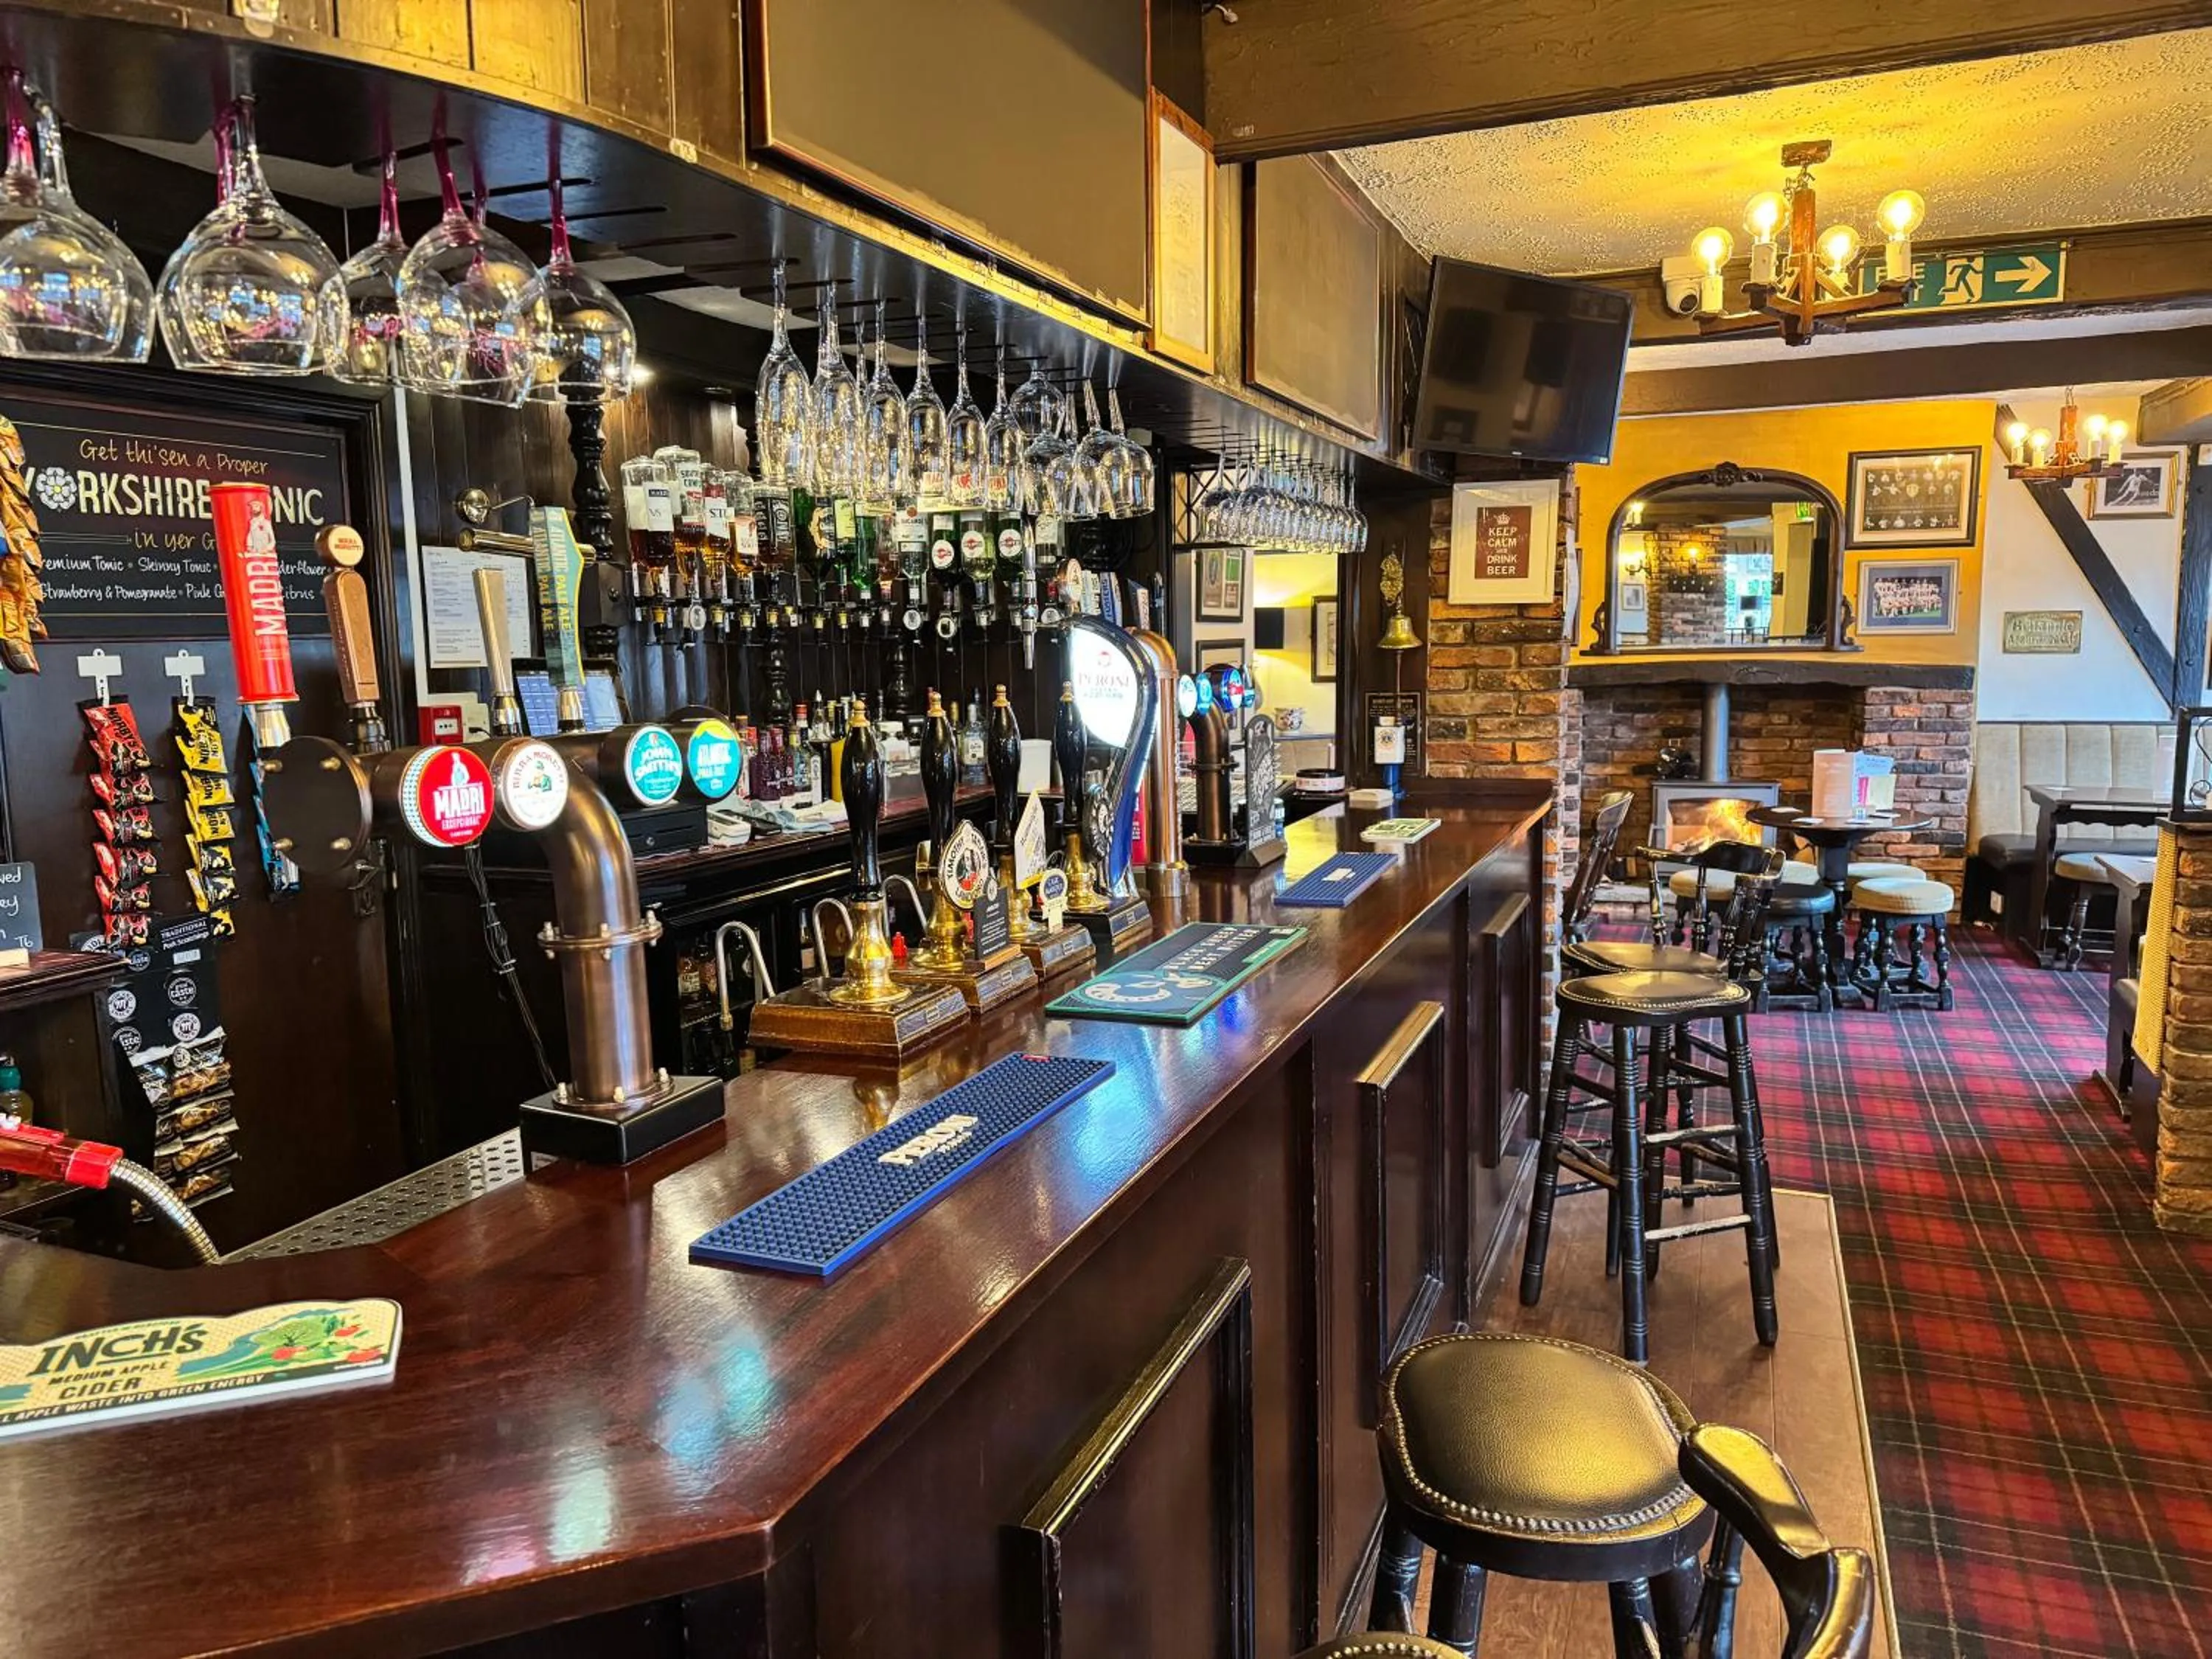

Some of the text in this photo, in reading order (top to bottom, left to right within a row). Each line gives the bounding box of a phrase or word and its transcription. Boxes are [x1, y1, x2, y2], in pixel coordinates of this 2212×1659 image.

[1876, 262, 1925, 281] FE
[80, 439, 118, 462] Get
[196, 453, 211, 470] a
[217, 453, 268, 477] Proper
[134, 527, 157, 549] in
[164, 532, 195, 552] yer
[1489, 526, 1517, 538] KEEP
[1487, 538, 1517, 548] CALM
[41, 554, 327, 576] remium Tonic Skinny Tonic derflower
[1486, 554, 1517, 565] DRINK
[1486, 565, 1516, 576] BEER
[115, 584, 178, 602] Pomegranate
[1078, 672, 1130, 687] PERONI
[26, 1323, 209, 1377] INCH'S
[49, 1361, 170, 1385] MEDIUM APPLE
[15, 1407, 60, 1421] APPLE
[66, 1399, 114, 1413] WASTE
[118, 1393, 155, 1405] INTO
[158, 1383, 207, 1398] GREEN
[209, 1374, 265, 1390] ENERGY
[58, 1377, 143, 1400] CIDER
